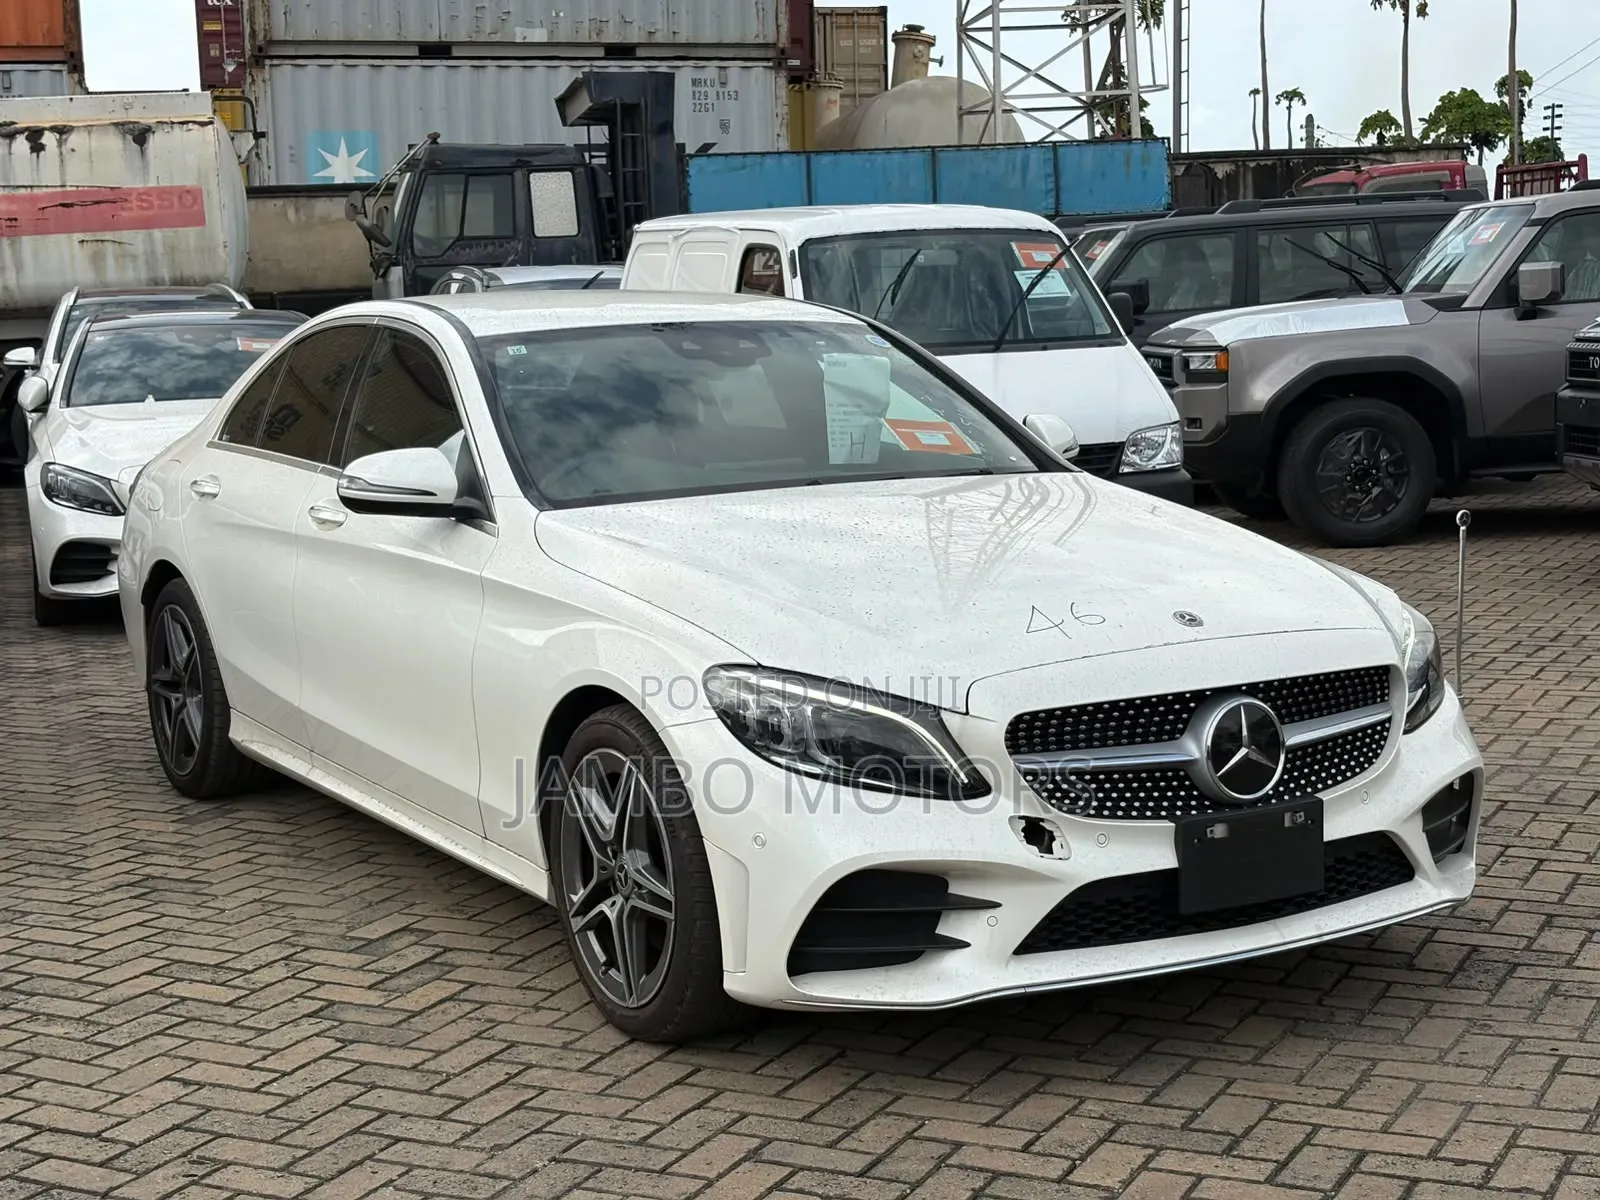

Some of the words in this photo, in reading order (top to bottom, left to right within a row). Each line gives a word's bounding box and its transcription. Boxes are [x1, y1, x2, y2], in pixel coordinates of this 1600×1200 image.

[691, 77, 716, 88] MRKU
[692, 102, 715, 113] 22G1
[1026, 602, 1106, 640] 46
